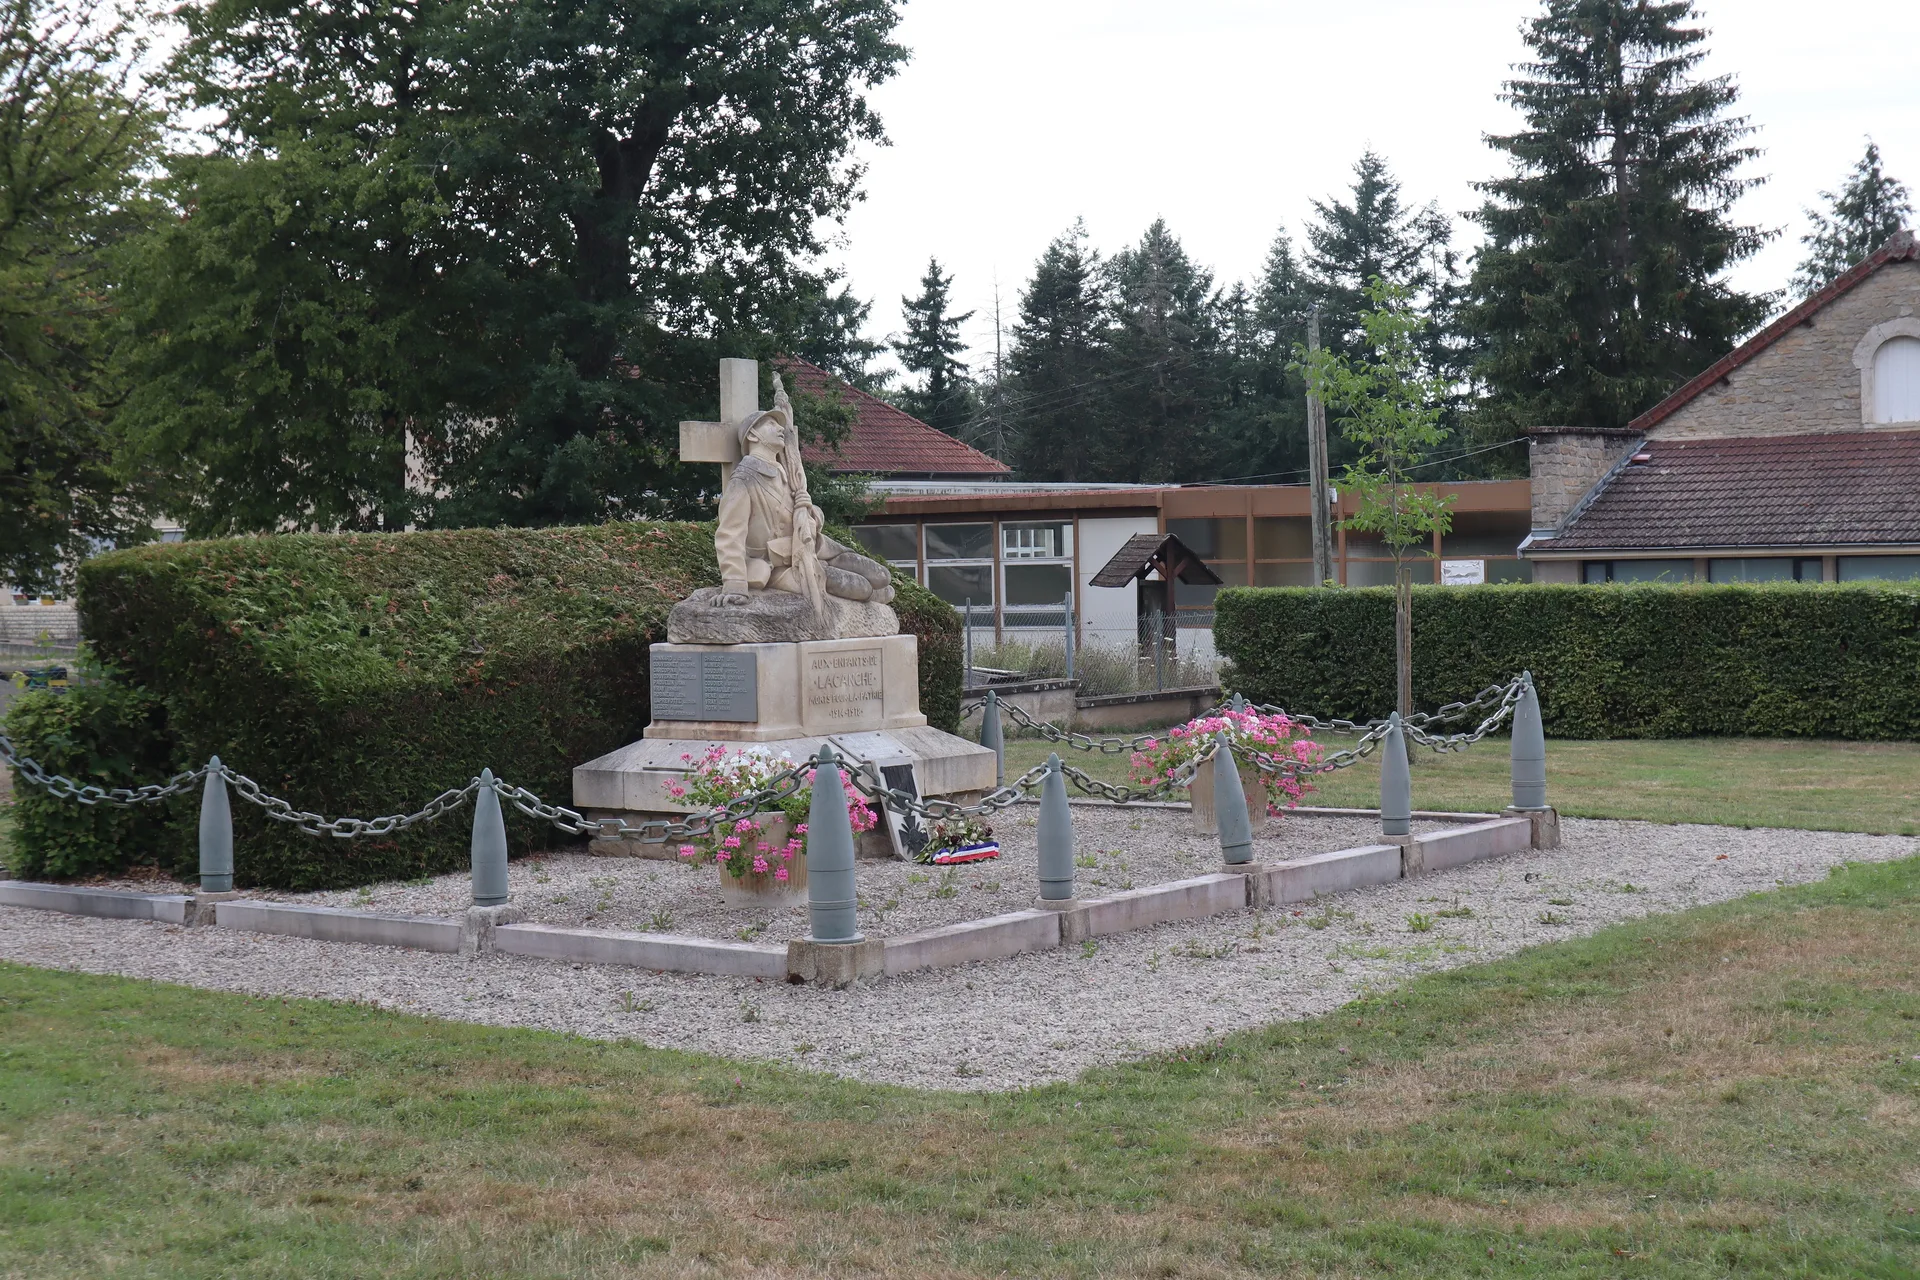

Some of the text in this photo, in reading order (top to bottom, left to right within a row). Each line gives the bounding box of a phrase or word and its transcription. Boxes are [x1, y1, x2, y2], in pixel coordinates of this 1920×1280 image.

[811, 655, 878, 670] AUX ENFANTS DE
[817, 672, 873, 689] LACANCHE
[808, 694, 831, 706] MORTS
[848, 692, 858, 702] LA
[859, 690, 883, 701] PATRIE
